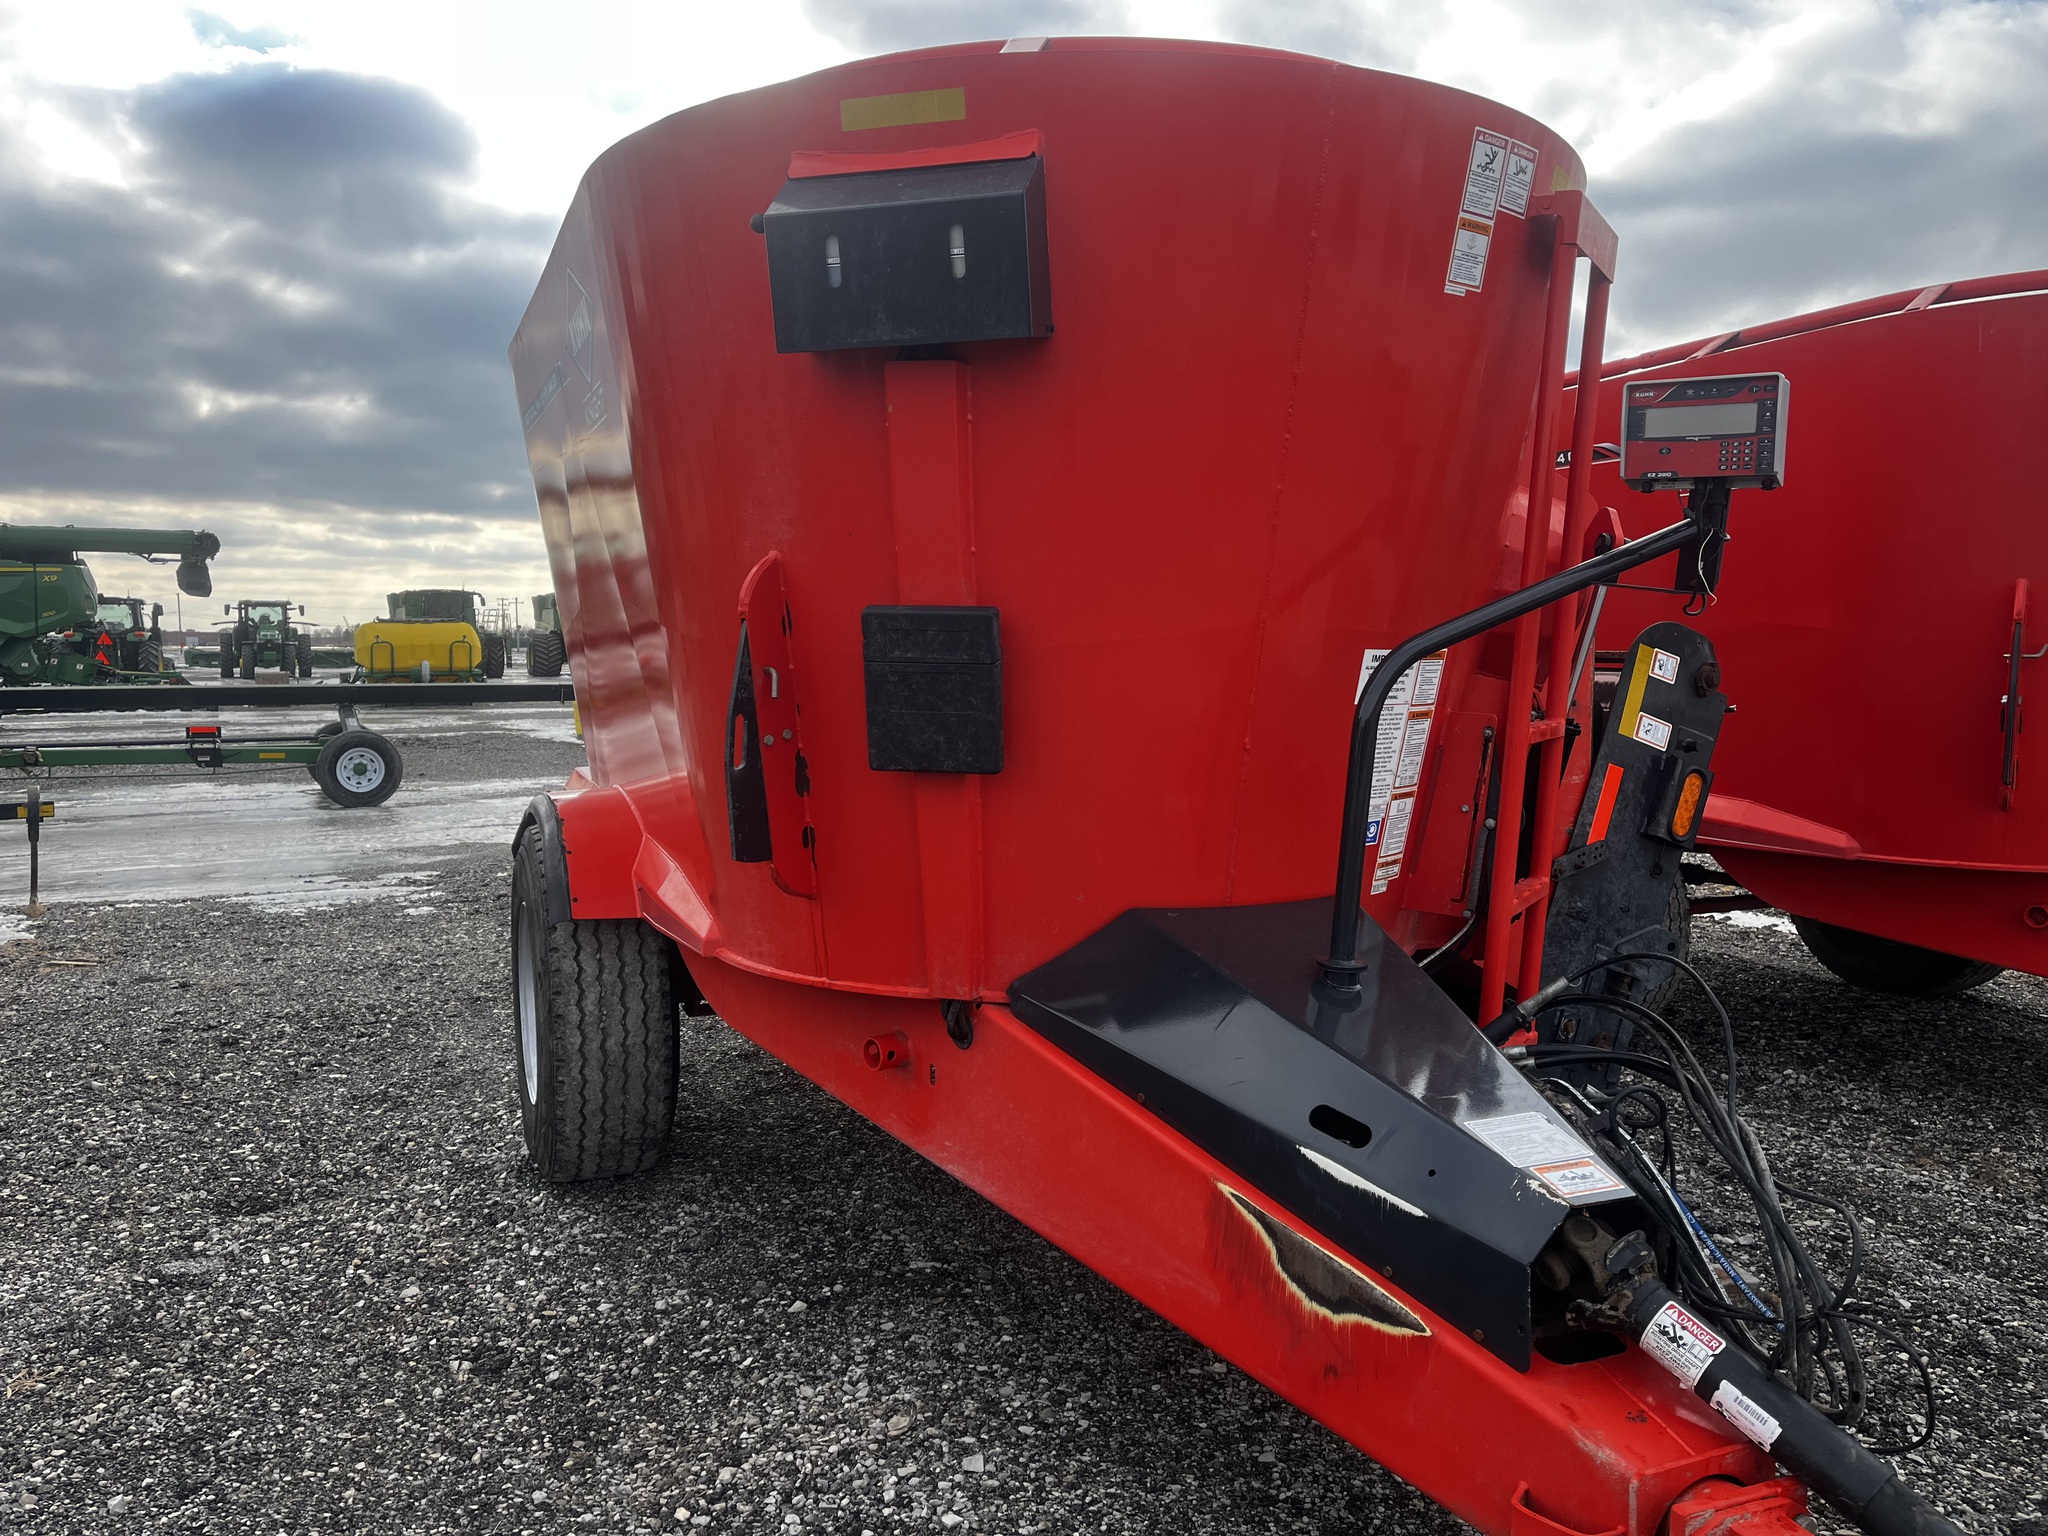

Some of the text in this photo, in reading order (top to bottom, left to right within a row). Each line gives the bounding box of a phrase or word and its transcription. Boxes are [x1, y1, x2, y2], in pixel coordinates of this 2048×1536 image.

[1485, 134, 1505, 148] DANGER
[1468, 223, 1488, 232] WARNING
[1719, 1259, 1736, 1278] MSHA
[1738, 1280, 1766, 1312] RESISTANT
[1677, 1315, 1720, 1350] DANGER
[1649, 1330, 1699, 1370] ROTATING DRIVE SHAFT
[1654, 1344, 1686, 1370] KEEP AWAY!
